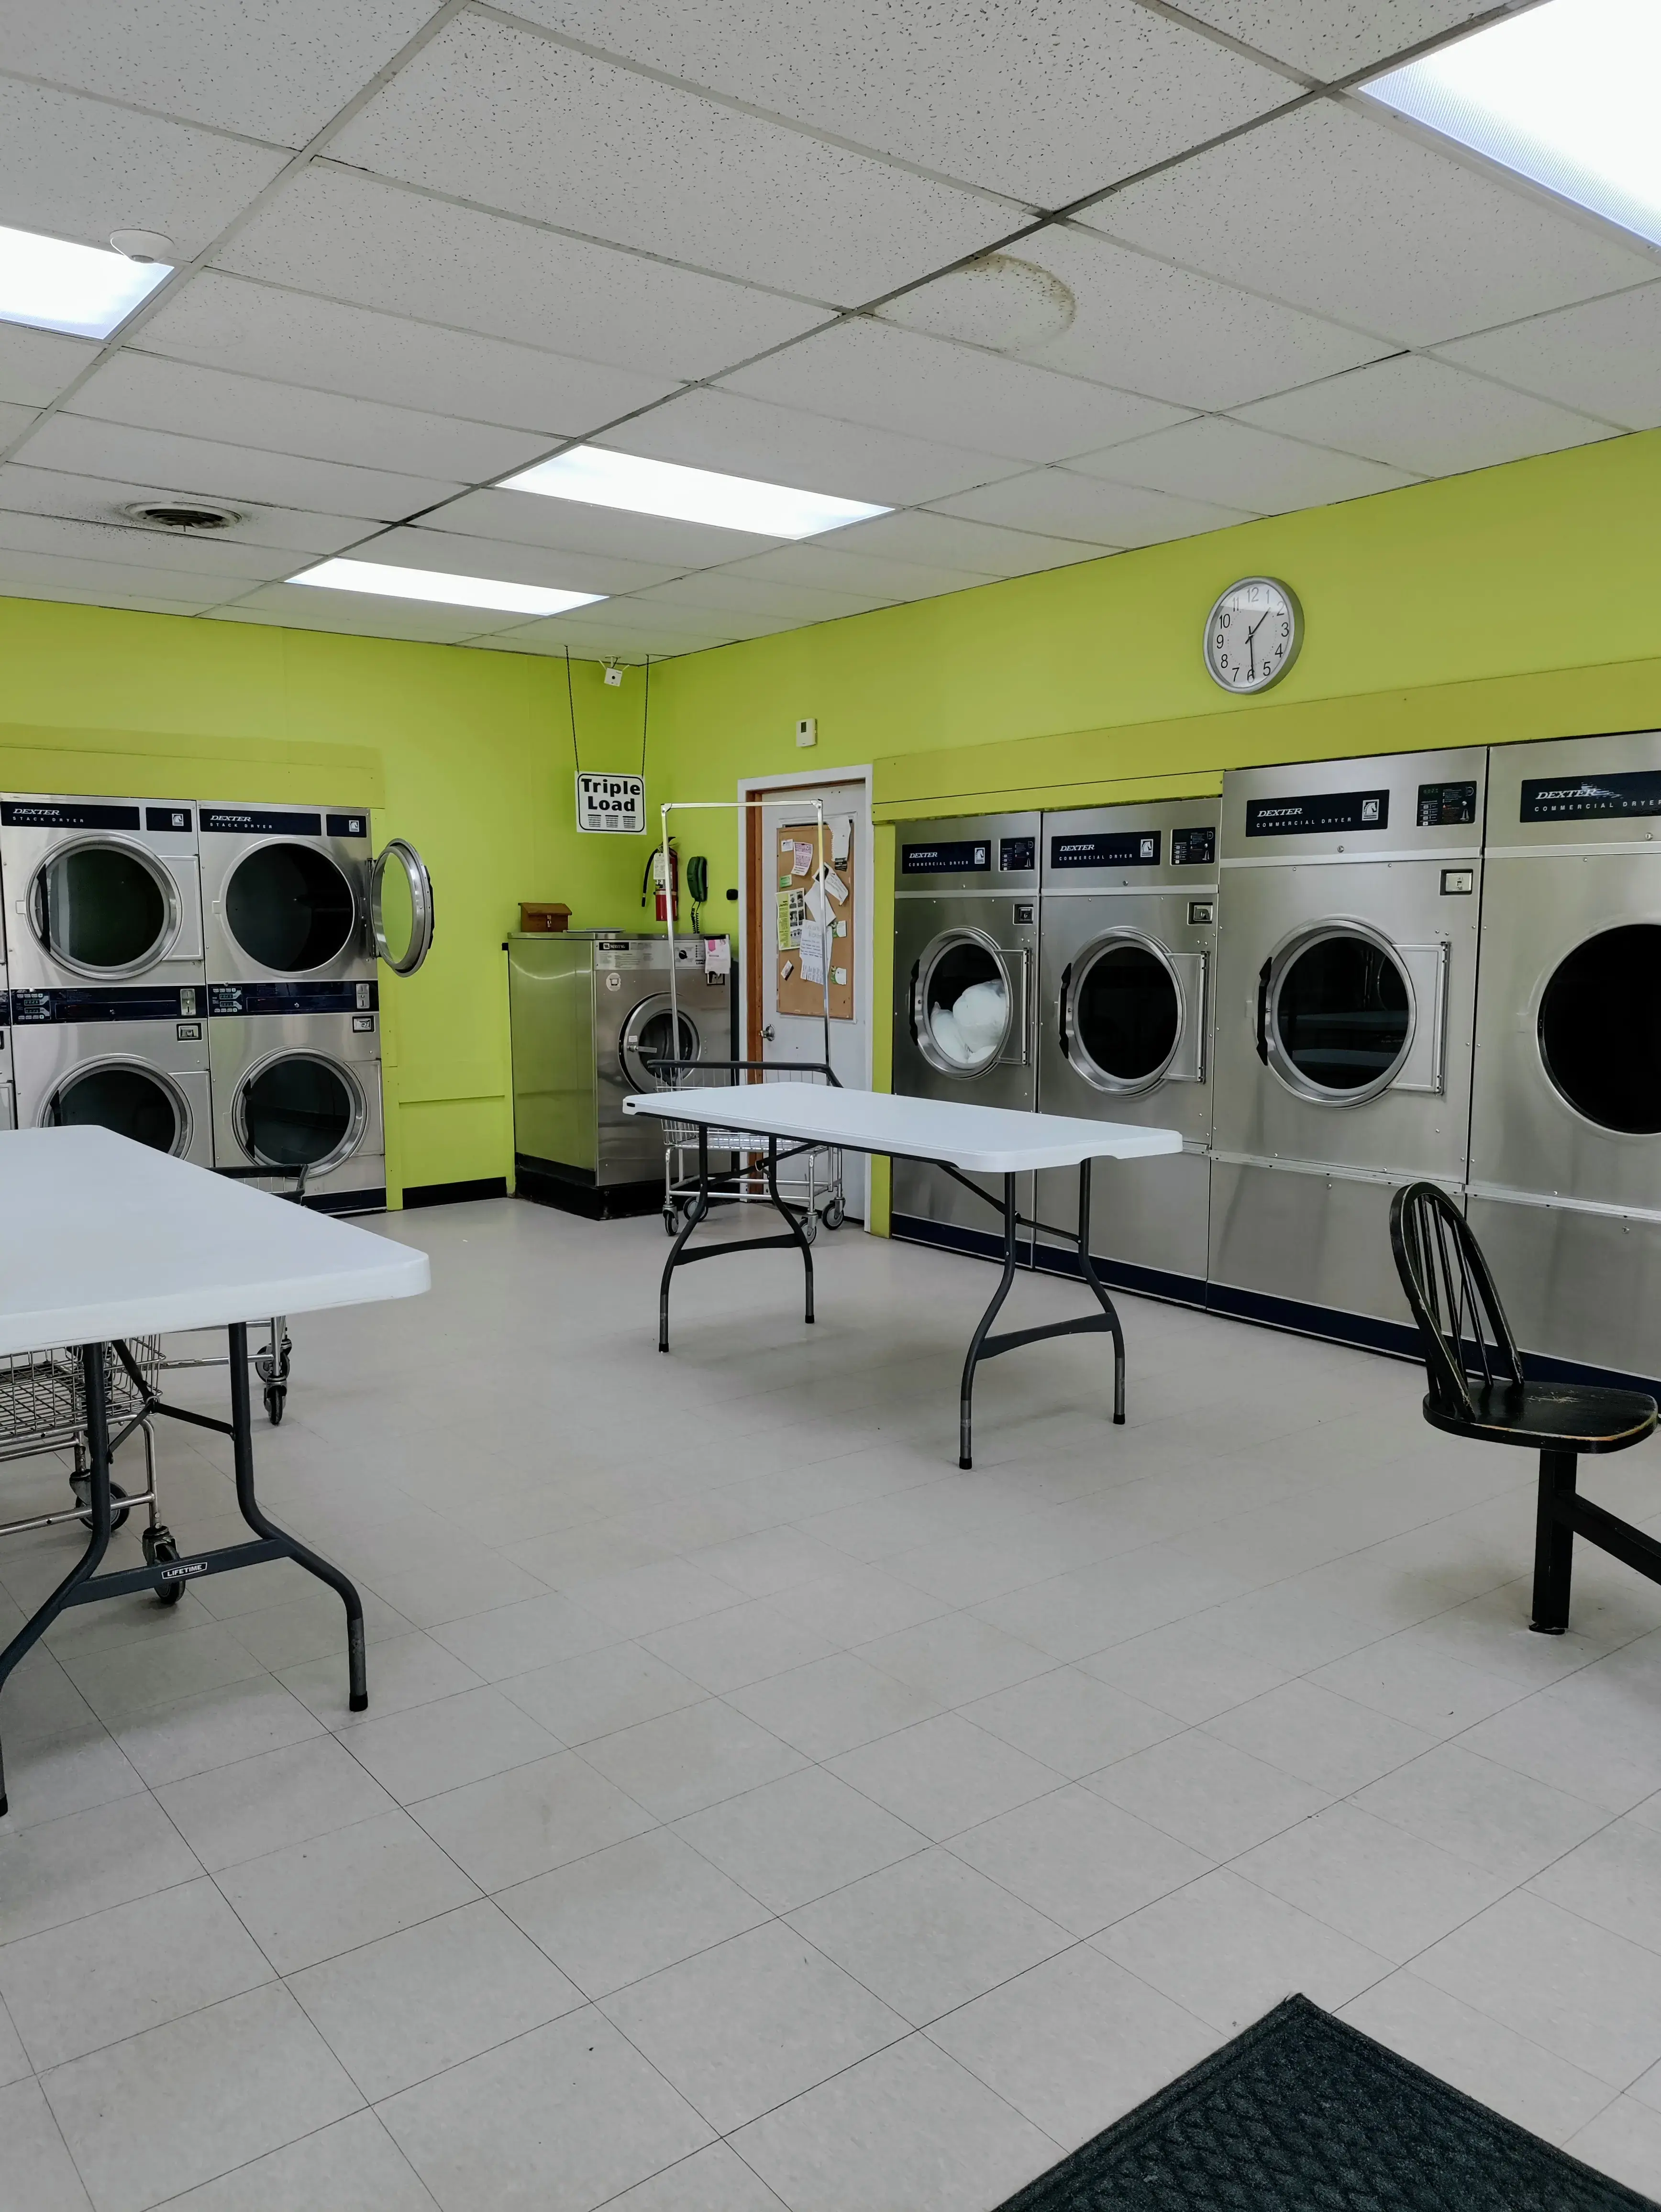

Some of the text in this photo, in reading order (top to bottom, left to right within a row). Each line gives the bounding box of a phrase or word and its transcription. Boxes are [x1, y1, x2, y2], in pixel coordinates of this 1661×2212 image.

[1247, 587, 1259, 603] 12
[1266, 589, 1270, 604] 1
[1232, 597, 1239, 612] 11
[1277, 601, 1285, 616] 2
[1219, 614, 1230, 629] 10
[1281, 622, 1289, 637] 3
[1217, 634, 1224, 649] 9
[1274, 643, 1283, 658] 4
[1221, 654, 1228, 668] 8
[1263, 661, 1271, 676] 5
[1232, 667, 1240, 682] 7
[1247, 669, 1255, 684] 6
[581, 778, 641, 797] Triple
[1535, 789, 1596, 799] DEXTER
[588, 796, 635, 812] Load
[1535, 803, 1614, 812] COMMERCIAL
[1257, 808, 1303, 817] DEXTER
[167, 1564, 202, 1577] LIFETIME
